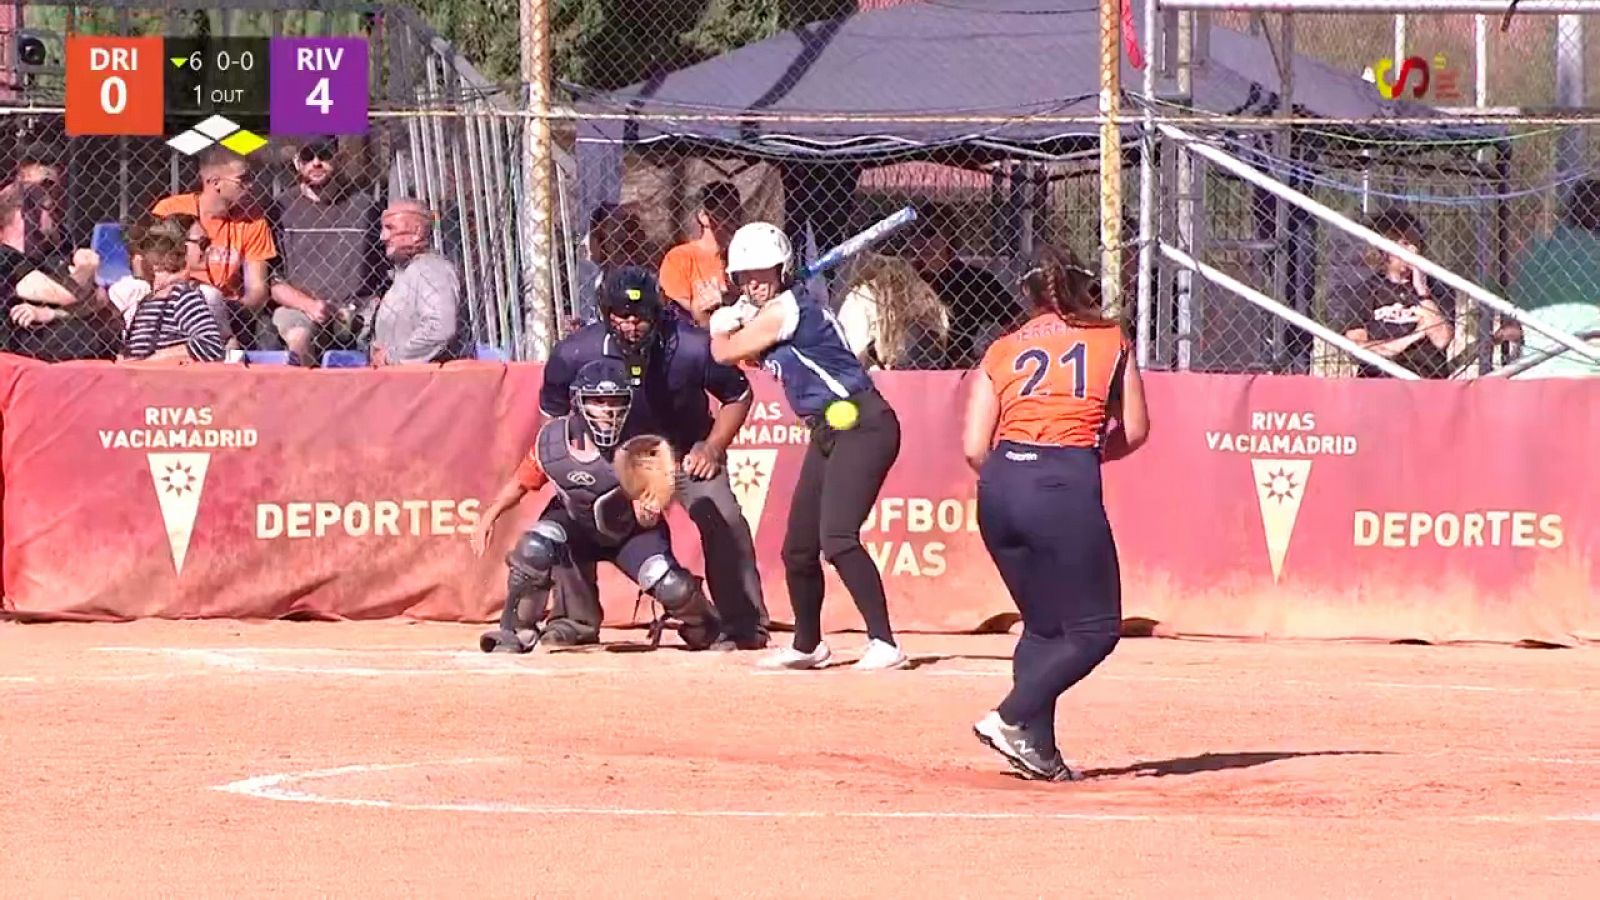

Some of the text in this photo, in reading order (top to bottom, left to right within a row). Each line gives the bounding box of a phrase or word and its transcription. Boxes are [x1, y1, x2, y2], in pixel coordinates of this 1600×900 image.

[1014, 341, 1087, 398] 21
[144, 407, 213, 426] RIVAS
[750, 401, 783, 420] AS
[1252, 411, 1315, 432] RIVAS
[99, 429, 258, 450] VACIAMADRID
[1206, 431, 1357, 455] VACIAMADRID
[255, 498, 482, 540] DEPORTES
[1353, 510, 1564, 548] DEPORTES
